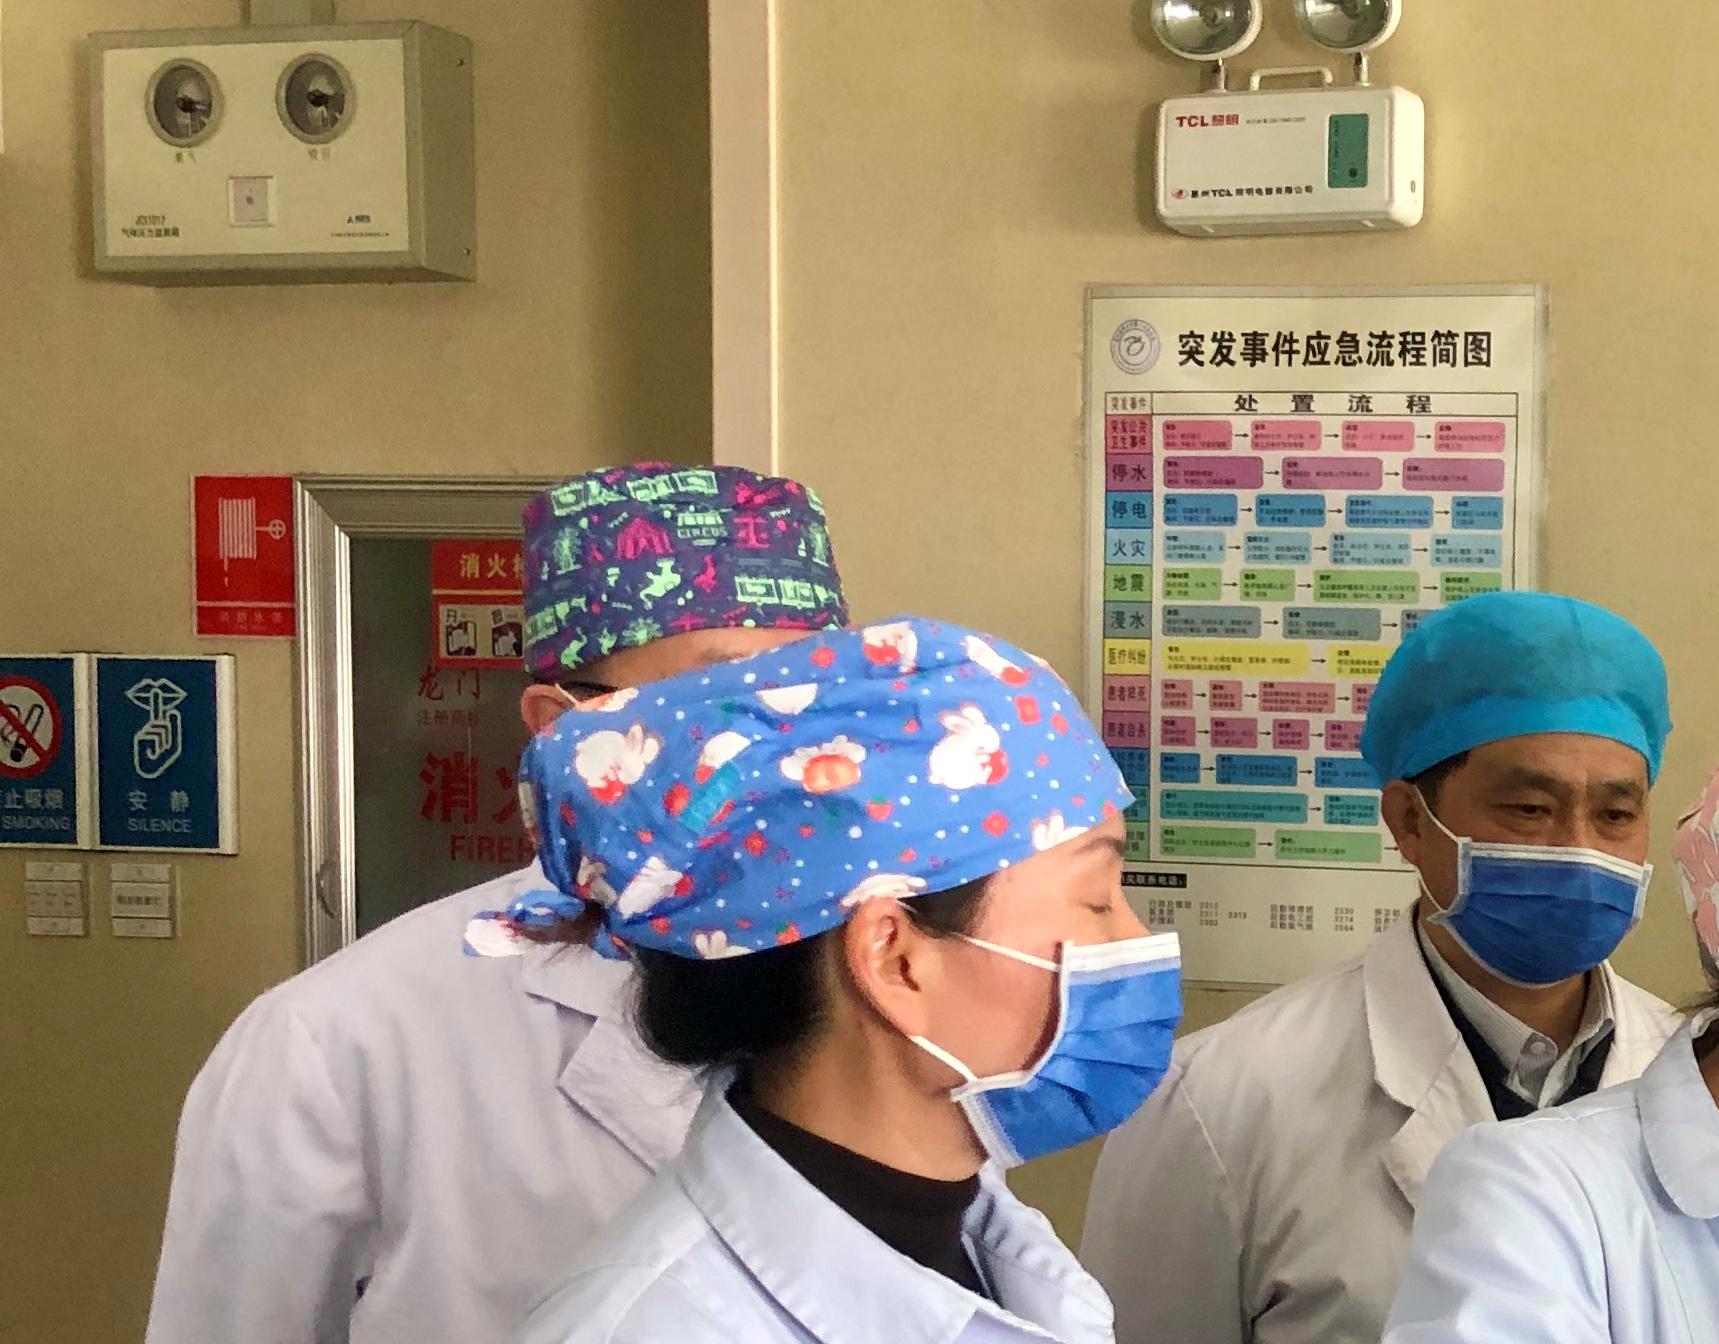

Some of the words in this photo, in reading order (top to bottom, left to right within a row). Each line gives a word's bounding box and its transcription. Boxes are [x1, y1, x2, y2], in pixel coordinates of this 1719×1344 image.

[1178, 330, 1492, 367] 突发事件应急流程简图
[1111, 397, 1147, 411] 突发事件
[1234, 394, 1432, 413] 处置流程
[1112, 464, 1147, 482] 停水
[1112, 501, 1147, 519] 停电
[1112, 539, 1146, 557] 火灾
[1113, 573, 1144, 592] 地震
[0, 788, 65, 810] 止吸烟
[128, 789, 190, 813] 安静
[2, 816, 72, 831] SMOKING
[128, 818, 193, 834] SILENCE
